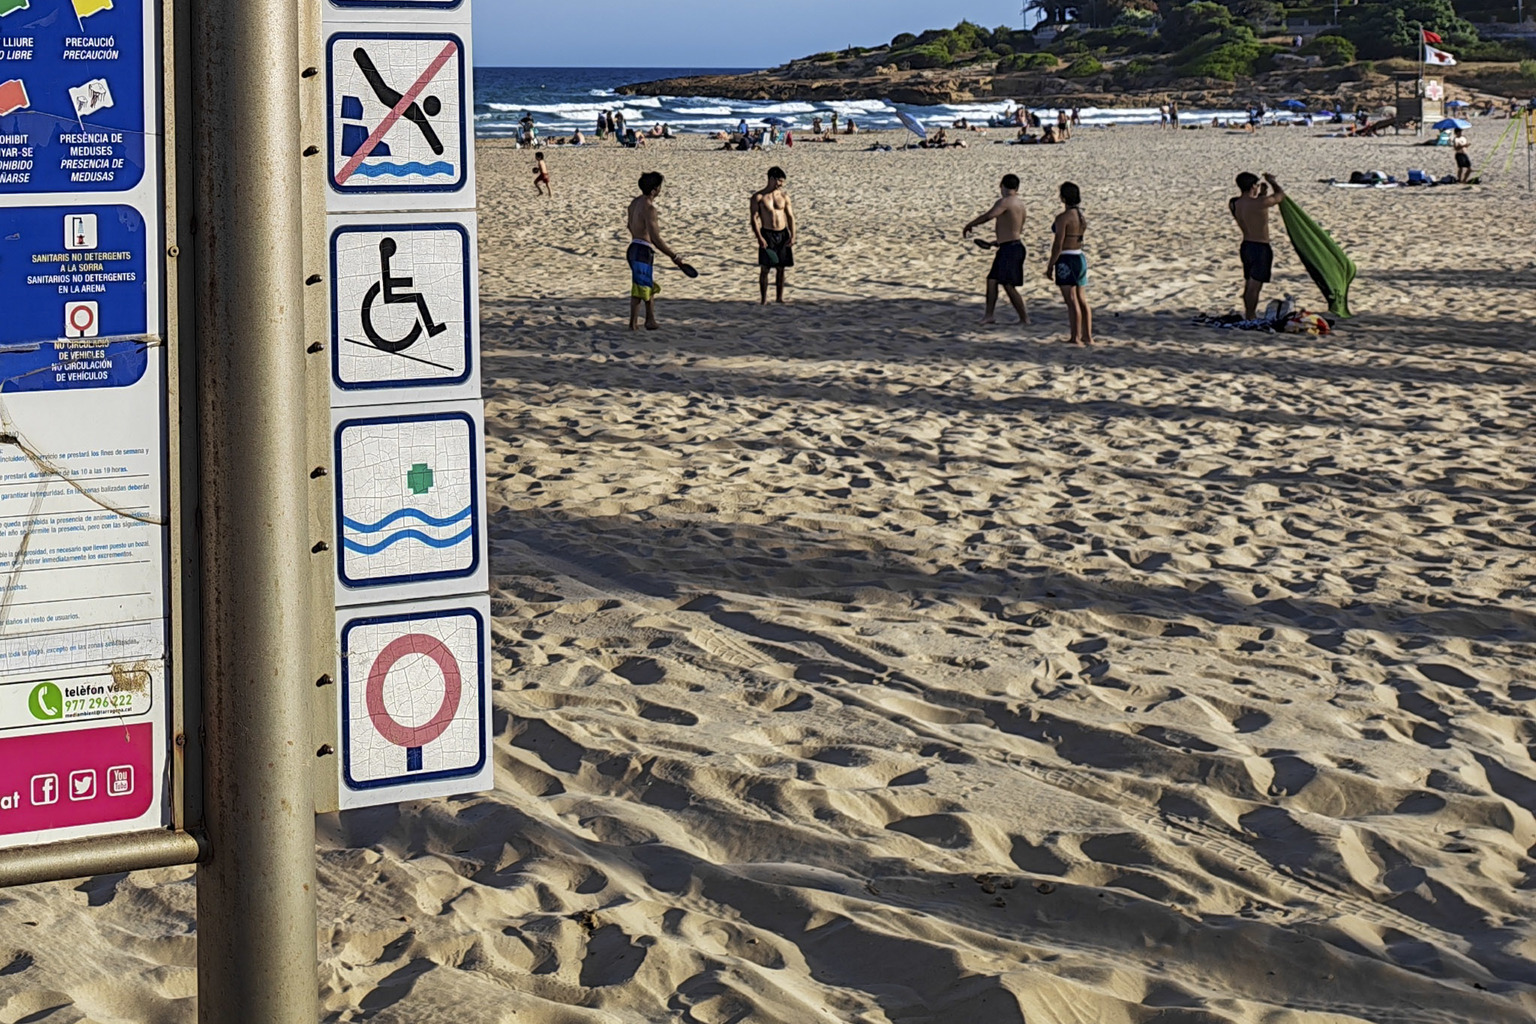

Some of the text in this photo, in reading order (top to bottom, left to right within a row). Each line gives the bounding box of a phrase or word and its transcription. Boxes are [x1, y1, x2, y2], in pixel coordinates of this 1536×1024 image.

[3, 37, 34, 47] LLIURE
[65, 35, 115, 47] PRECAUCIÓ
[6, 50, 33, 60] LIBRE
[63, 48, 119, 60] PRECAUCIÓN
[60, 132, 123, 144] PRESÈNCIA DE
[70, 146, 113, 156] MEDUSES
[61, 158, 124, 169] PRESENCIA DE
[70, 171, 114, 182] MEDUSAS
[32, 251, 131, 263] SANITARIS NO DETERGENTS
[65, 684, 104, 698] telèfon
[65, 694, 132, 711] 977 296 222
[114, 770, 127, 781] You
